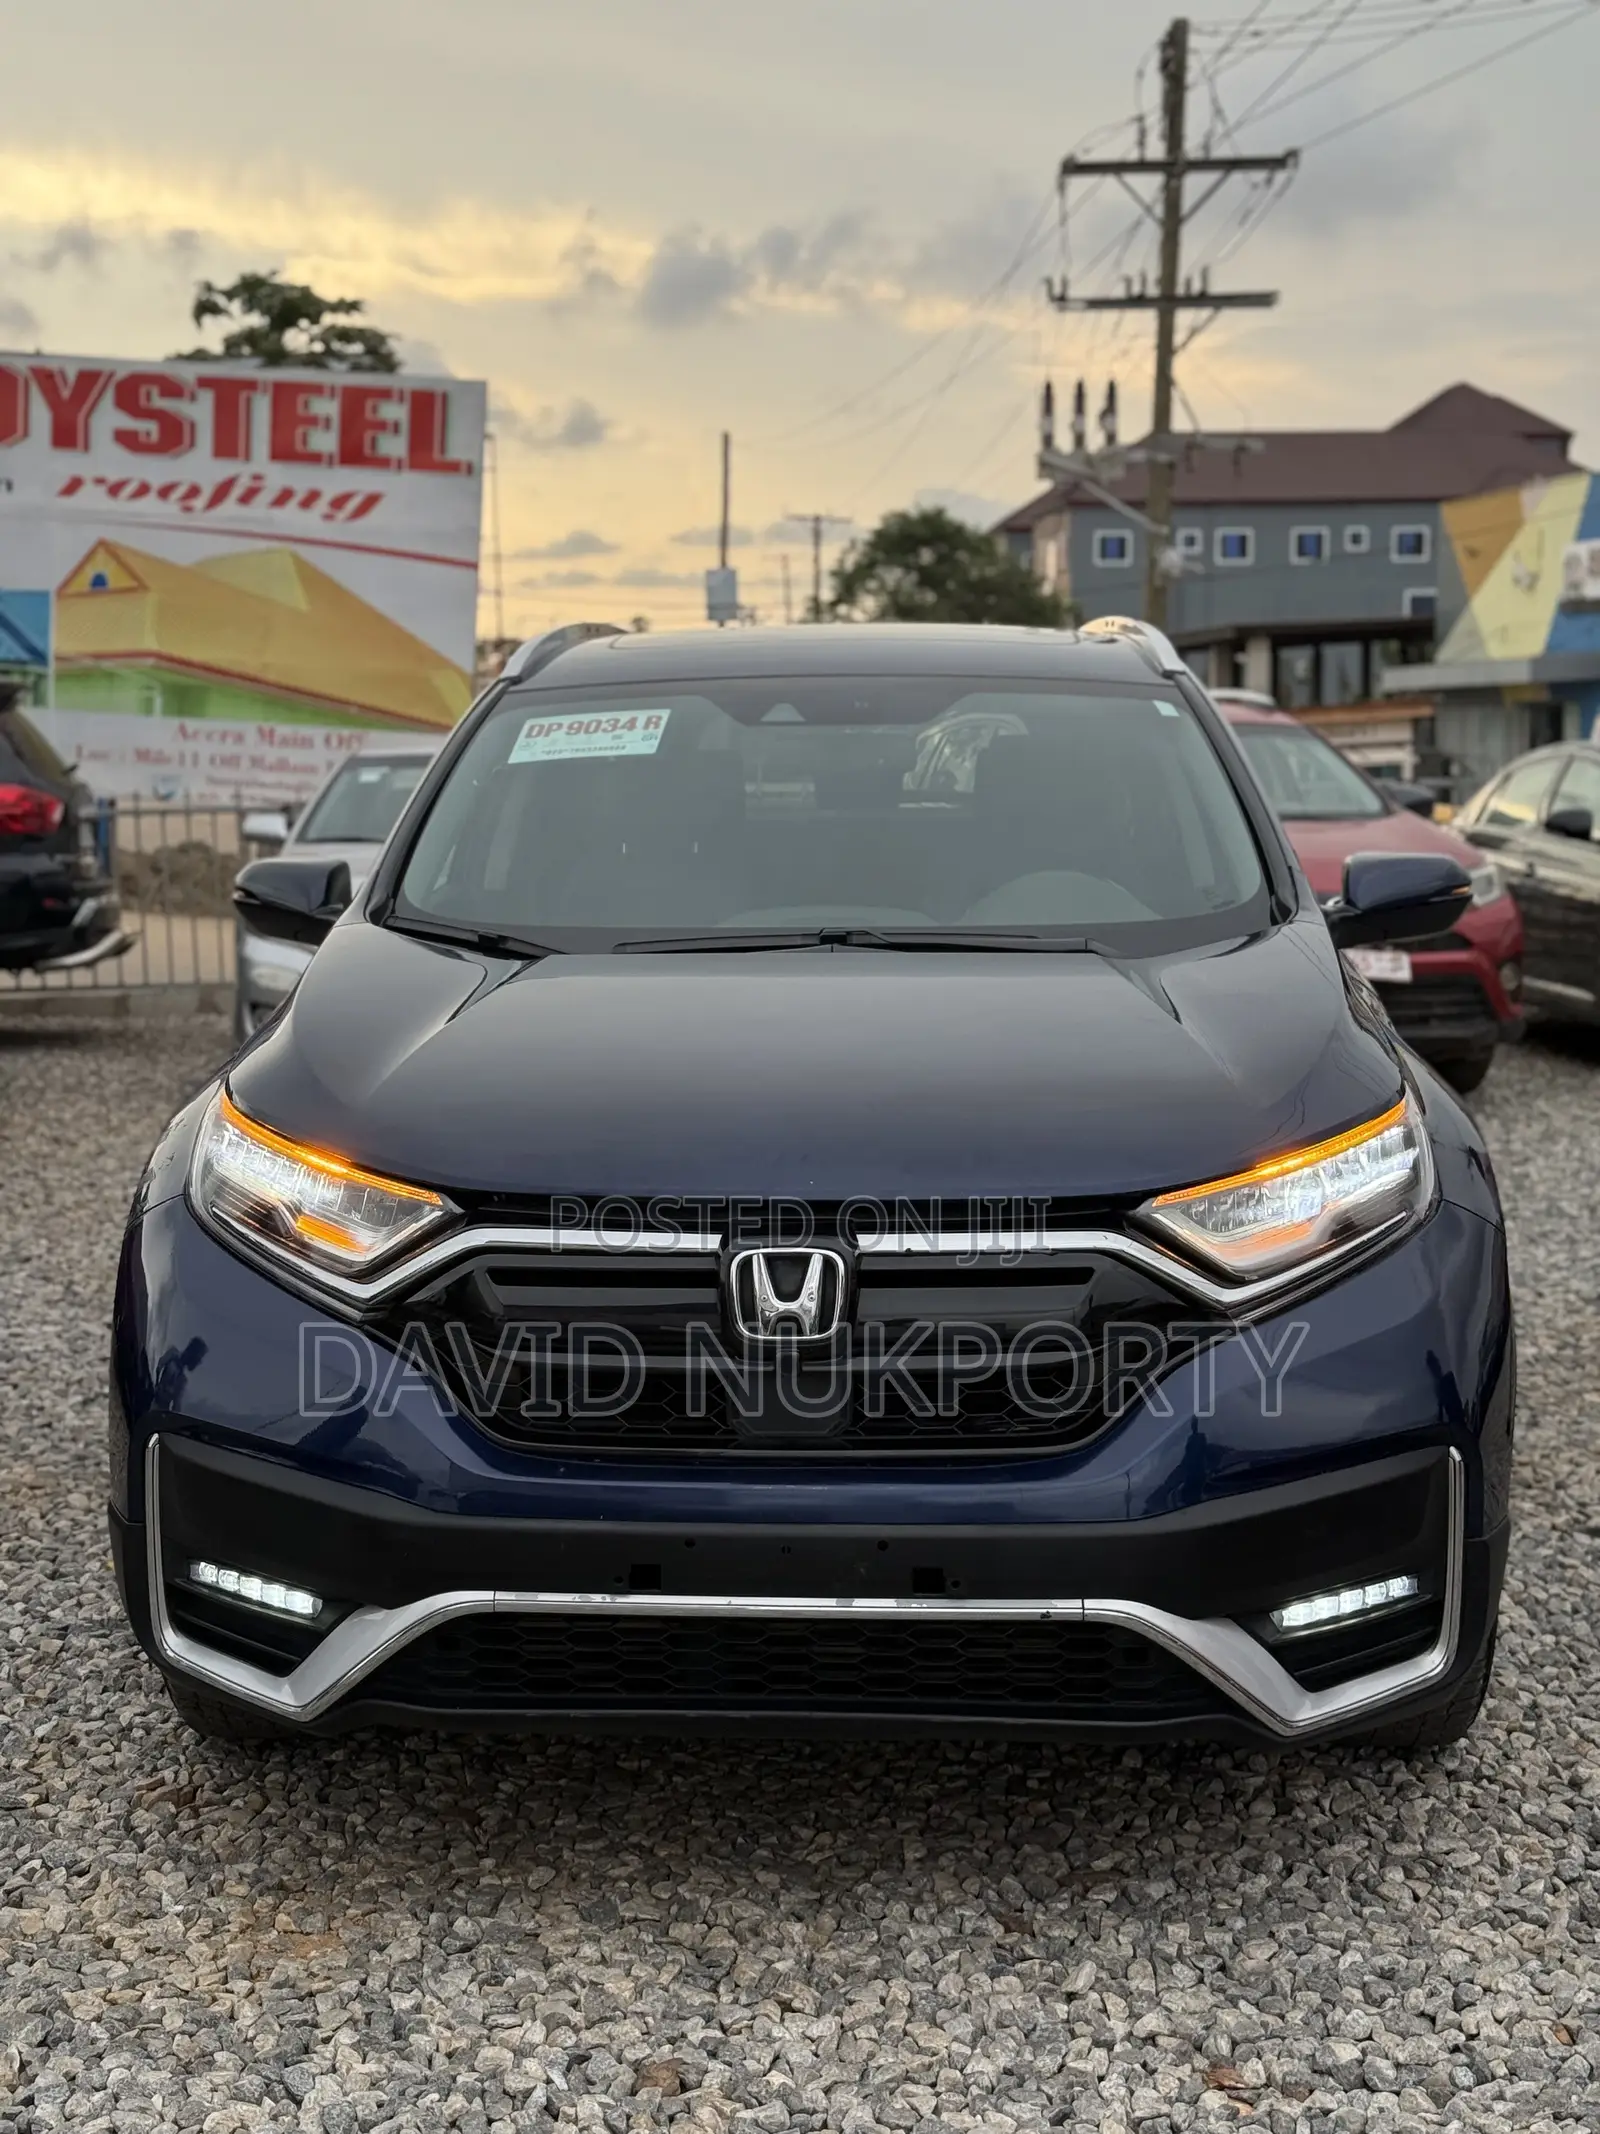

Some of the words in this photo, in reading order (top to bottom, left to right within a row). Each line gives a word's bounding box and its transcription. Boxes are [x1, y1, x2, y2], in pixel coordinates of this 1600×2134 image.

[57, 473, 387, 523] roofing
[256, 724, 316, 750] Main
[524, 722, 564, 739] DP
[565, 716, 639, 736] 9034
[643, 715, 663, 731] R
